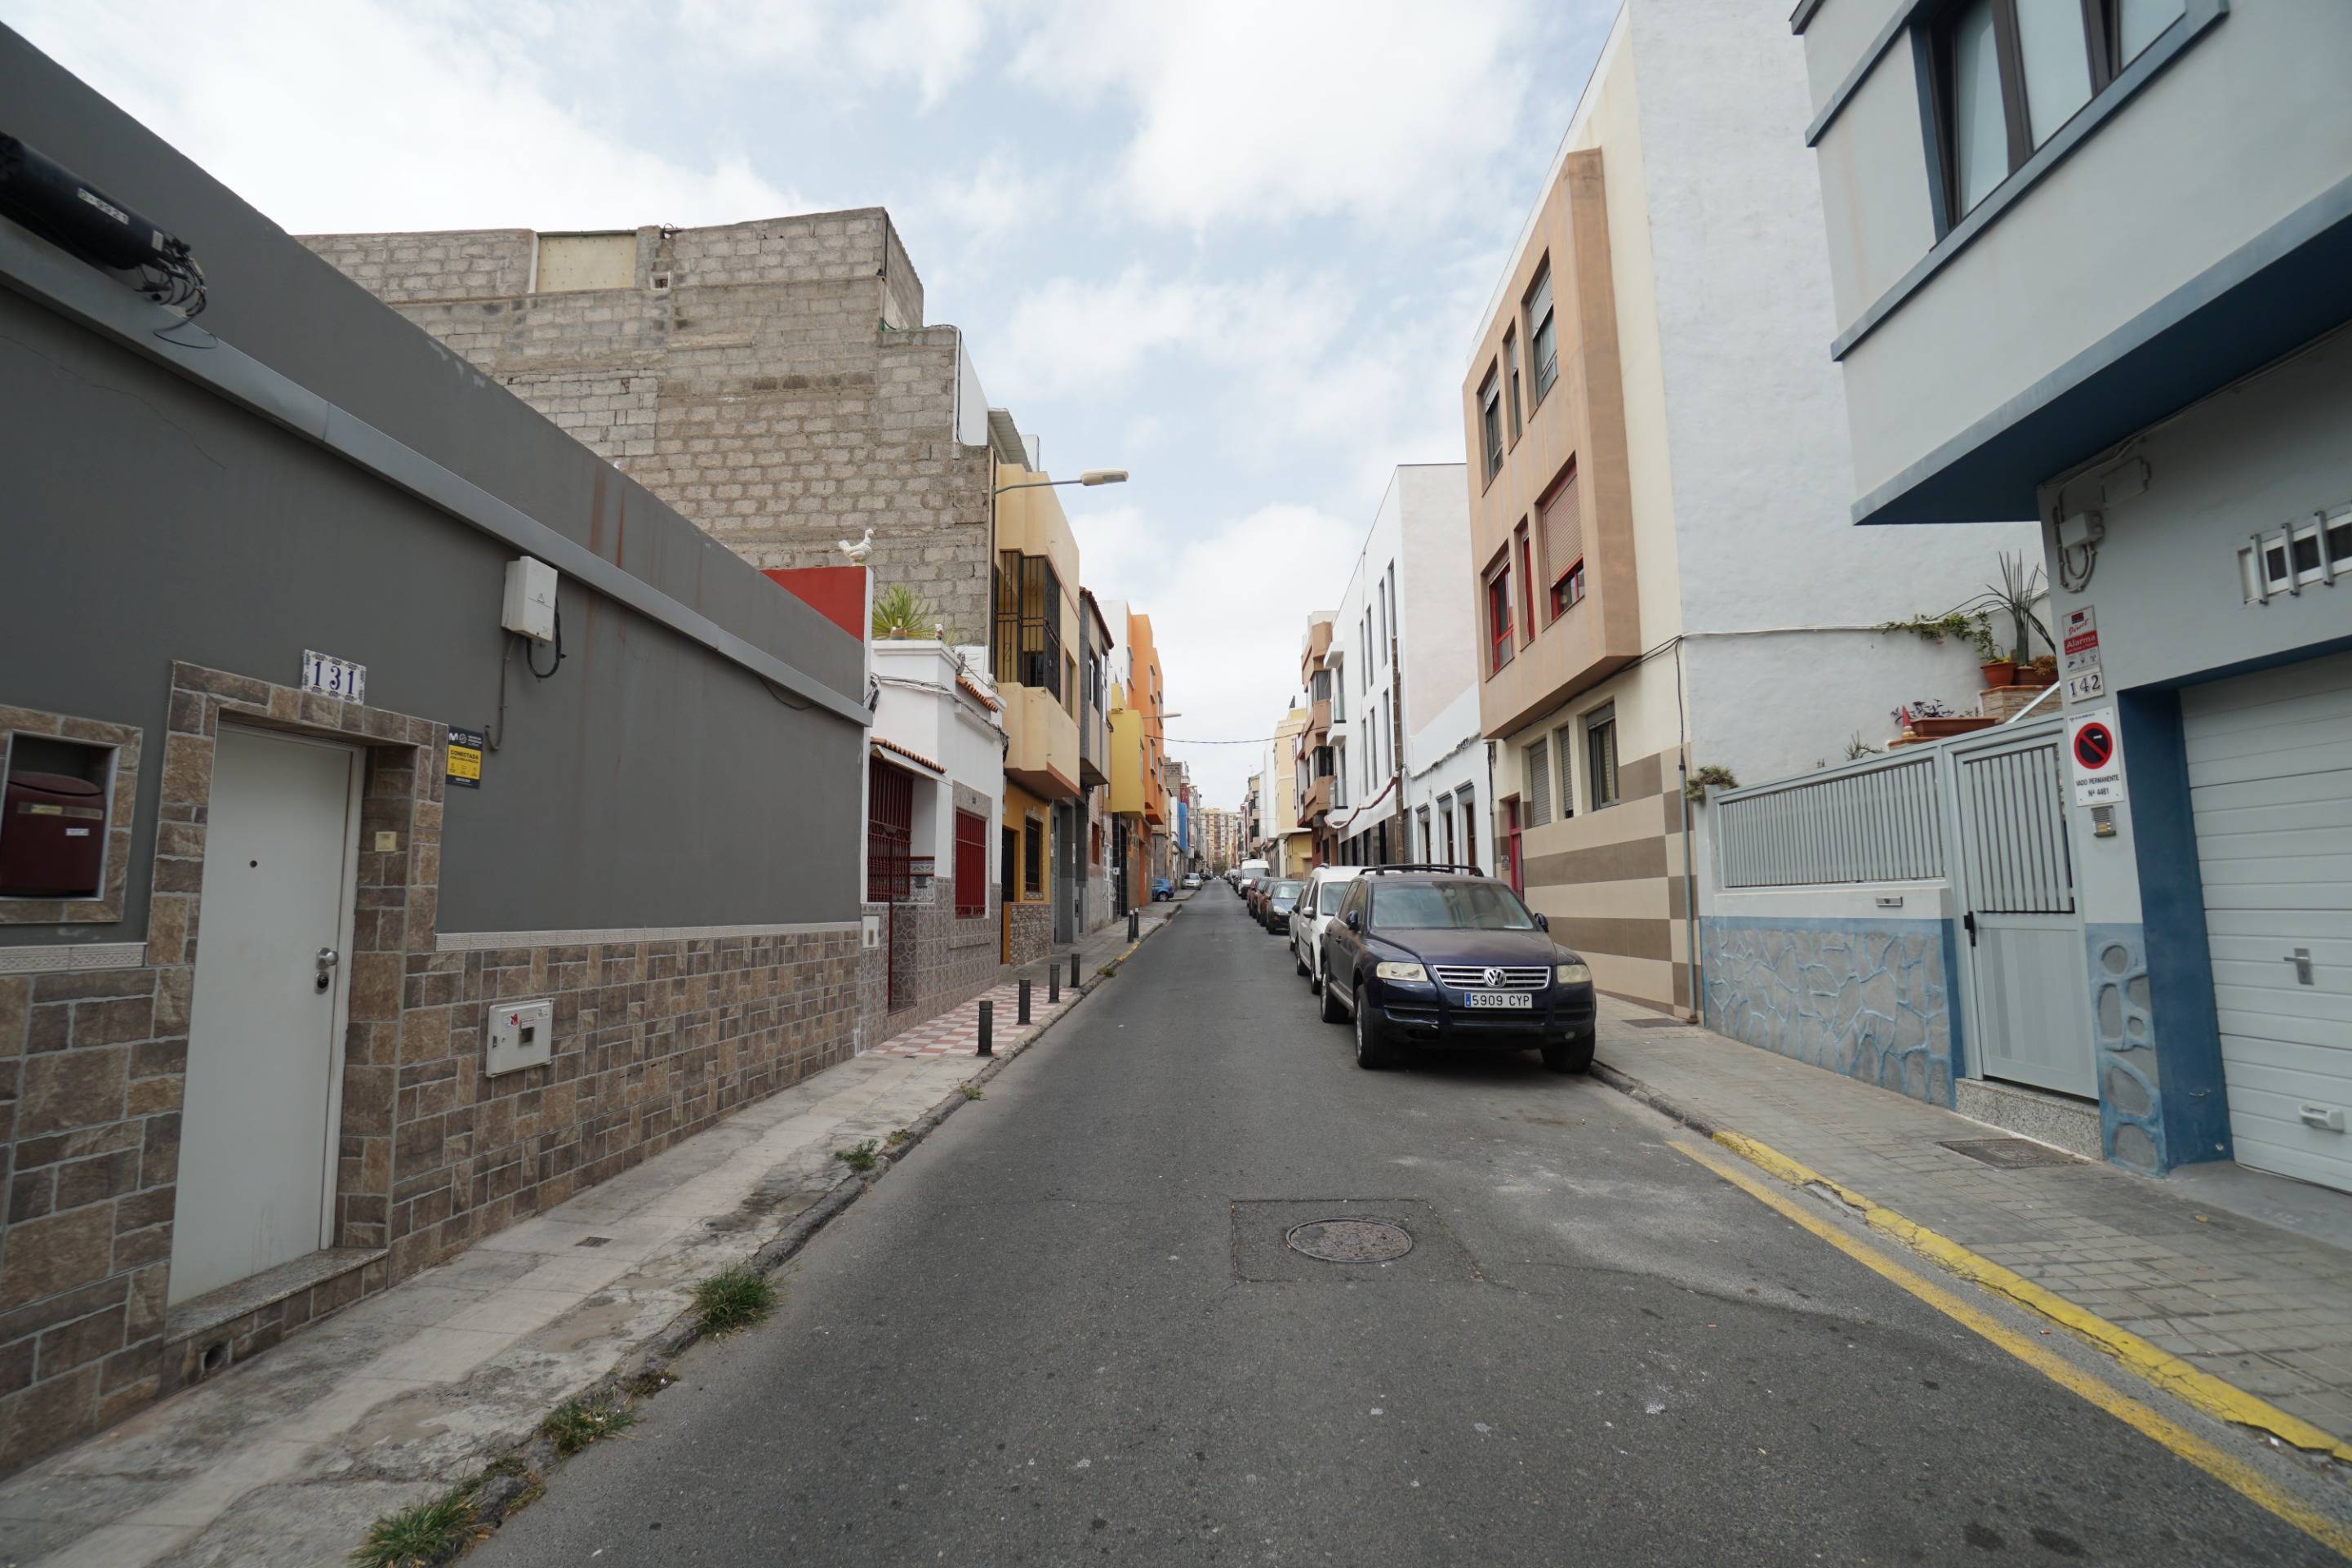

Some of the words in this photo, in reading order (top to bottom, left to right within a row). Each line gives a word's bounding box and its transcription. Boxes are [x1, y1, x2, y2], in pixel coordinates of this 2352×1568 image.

[2066, 635, 2096, 648] Alarma
[314, 661, 354, 695] 131
[2069, 675, 2100, 697] 142
[2089, 774, 2120, 784] PERMANENTE
[1472, 995, 1503, 1006] 5909
[1508, 995, 1530, 1006] CYP
